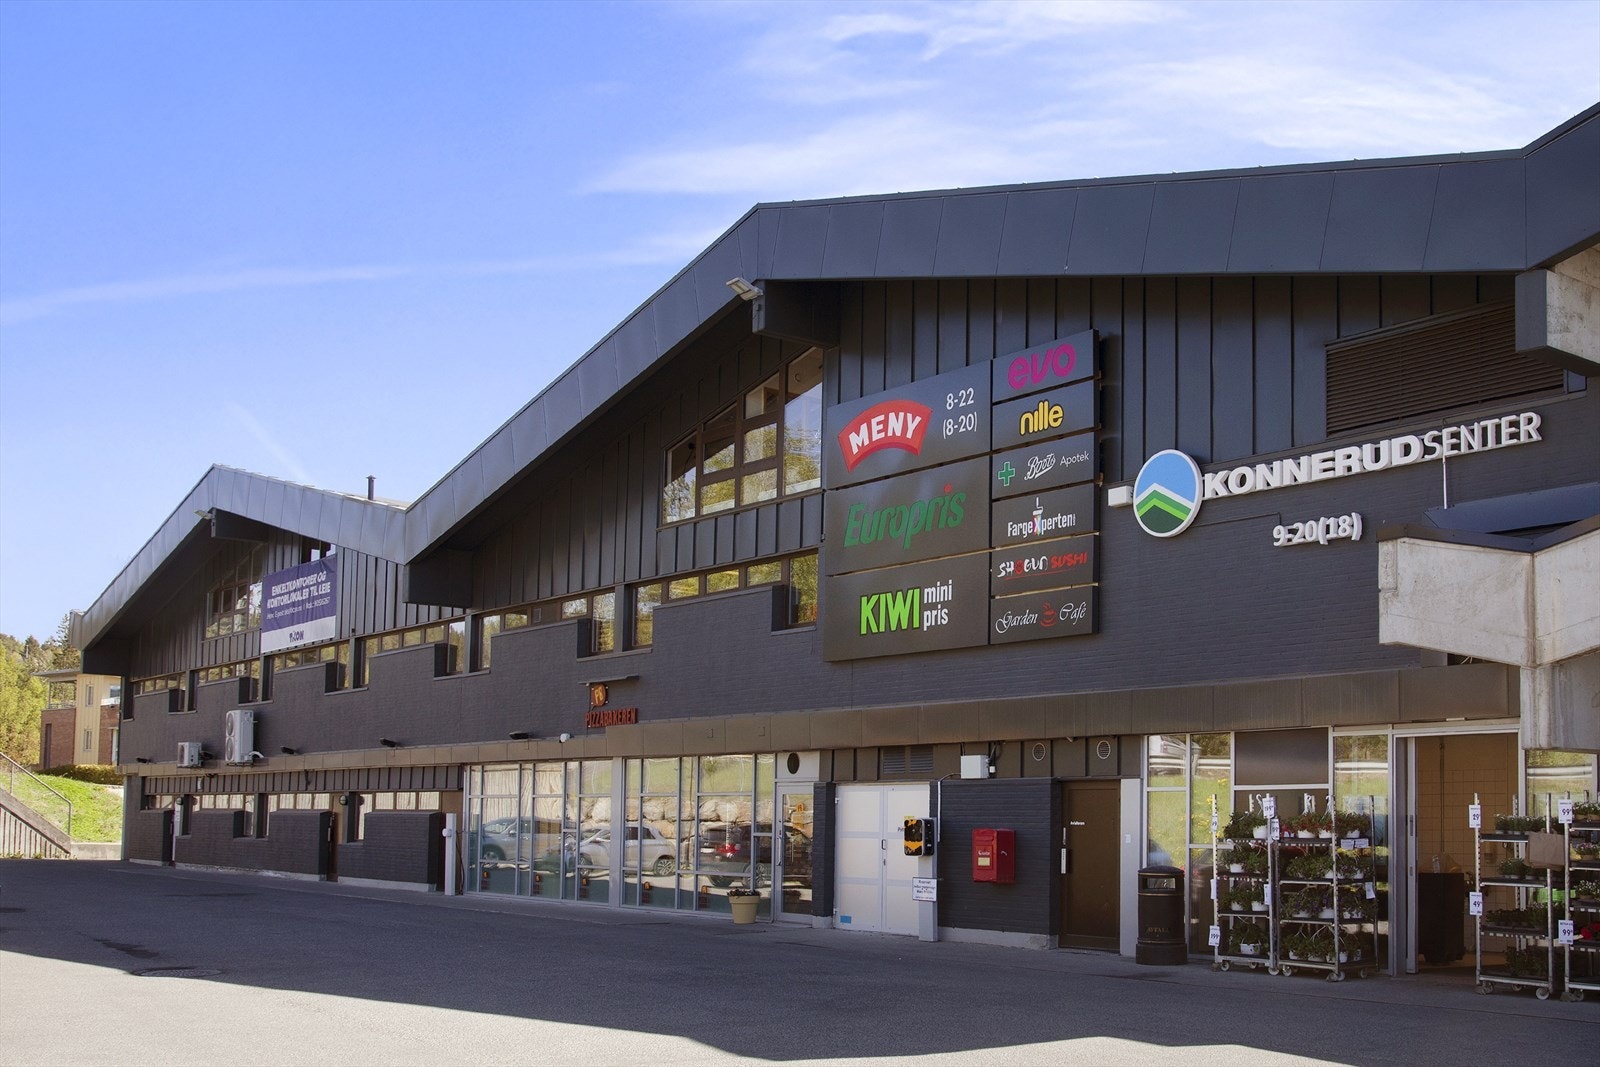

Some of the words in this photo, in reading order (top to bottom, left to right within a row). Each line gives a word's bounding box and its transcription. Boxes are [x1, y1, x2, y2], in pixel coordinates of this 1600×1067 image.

[1008, 343, 1076, 389] evo
[946, 387, 975, 410] 8-22
[942, 411, 978, 440] (8-20)
[1019, 399, 1064, 436] nille
[848, 412, 922, 455] MENY
[1024, 453, 1056, 480] Boots
[1060, 451, 1090, 467] Apotek
[843, 483, 967, 549] Europris
[1272, 511, 1363, 548] 9-20(18)
[1050, 551, 1088, 569] SUSHI
[318, 571, 327, 582] OG
[860, 586, 921, 635] KIWI
[923, 579, 953, 604] mini
[923, 604, 949, 631] pris
[995, 609, 1039, 634] Garden
[584, 708, 636, 728] PIZZABAKEREN
